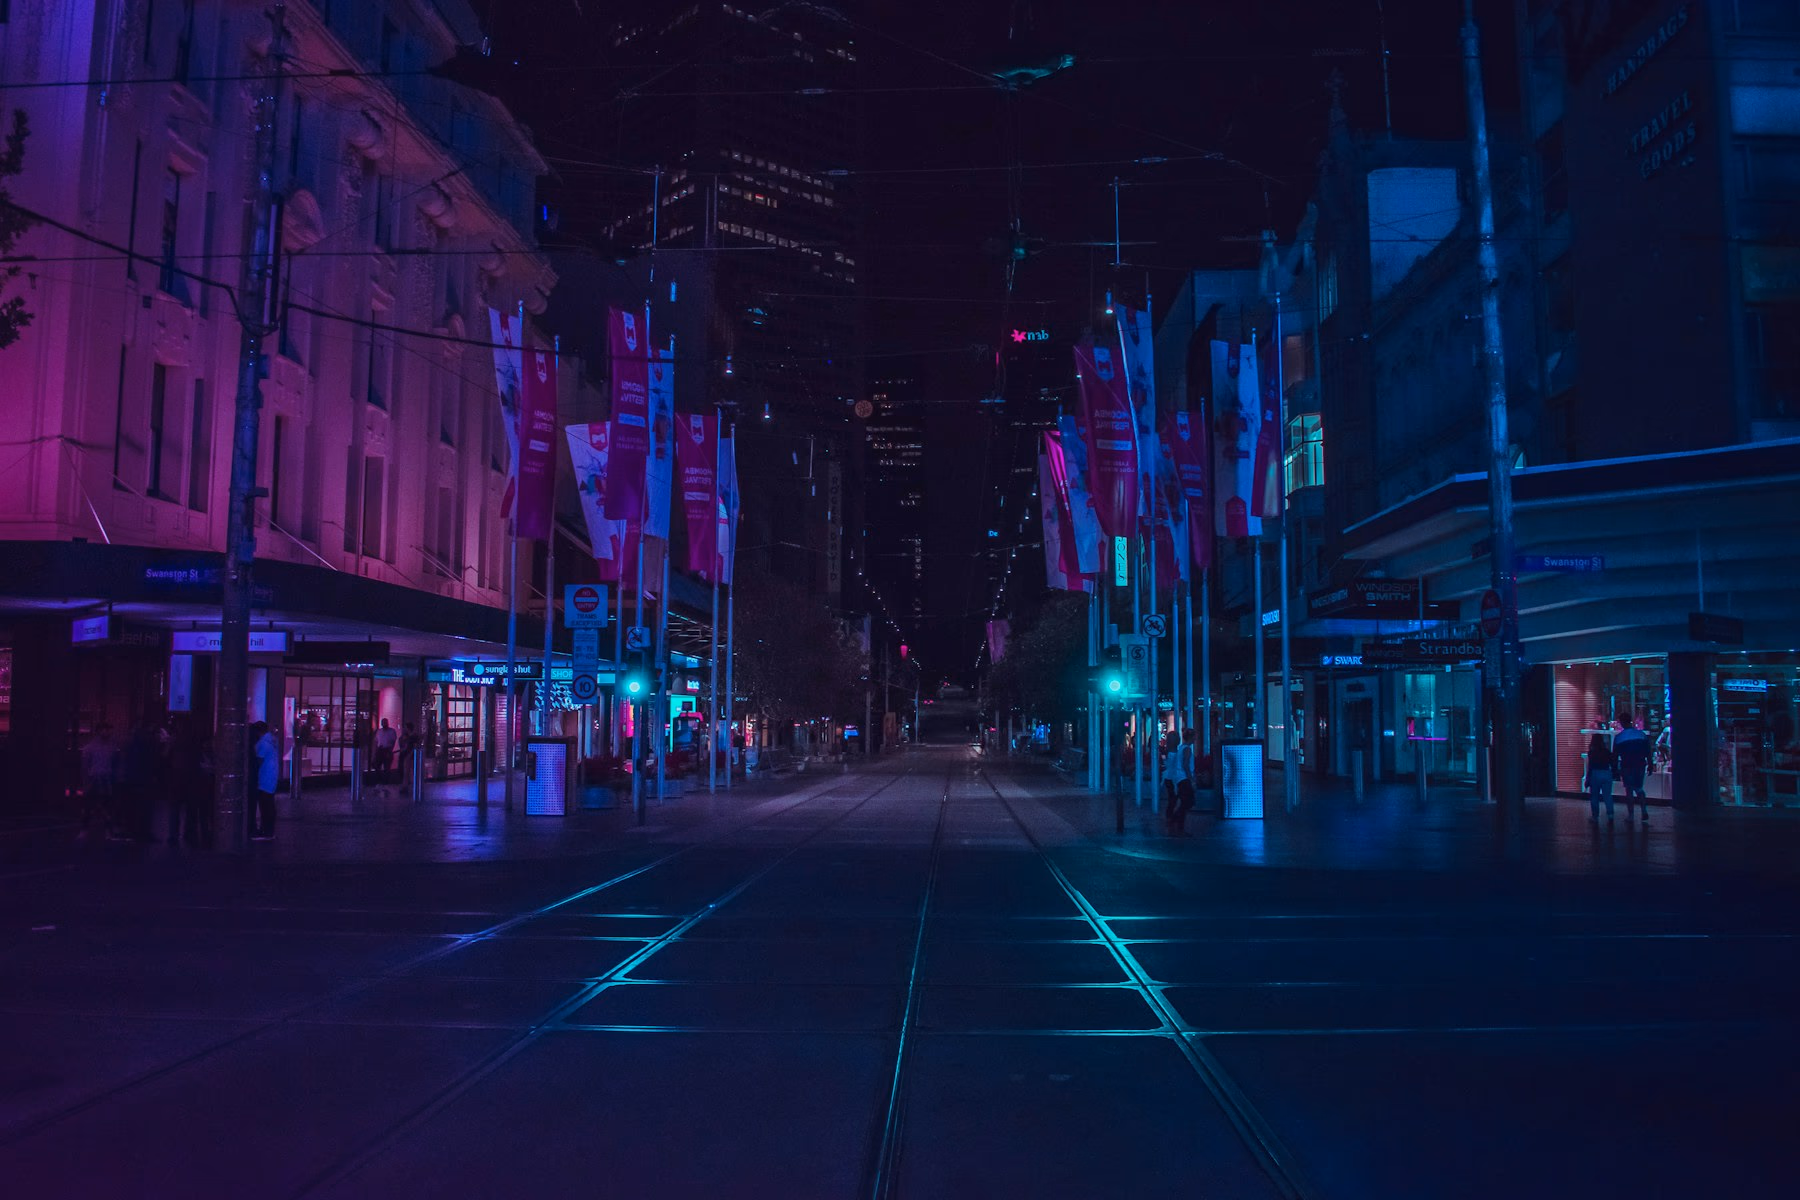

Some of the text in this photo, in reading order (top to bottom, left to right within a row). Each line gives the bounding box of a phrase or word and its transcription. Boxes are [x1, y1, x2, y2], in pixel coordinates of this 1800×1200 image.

[1607, 6, 1689, 93] HANDBAGS
[1632, 89, 1692, 153] TRAVEL
[1638, 121, 1695, 178] GOODS
[1027, 330, 1049, 341] nab
[1543, 556, 1602, 568] Swanston St
[146, 568, 199, 578] Swanston St
[1366, 592, 1411, 601] SMITH
[251, 637, 265, 647] hill
[453, 669, 465, 682] THE
[485, 665, 532, 677] sunglas hut
